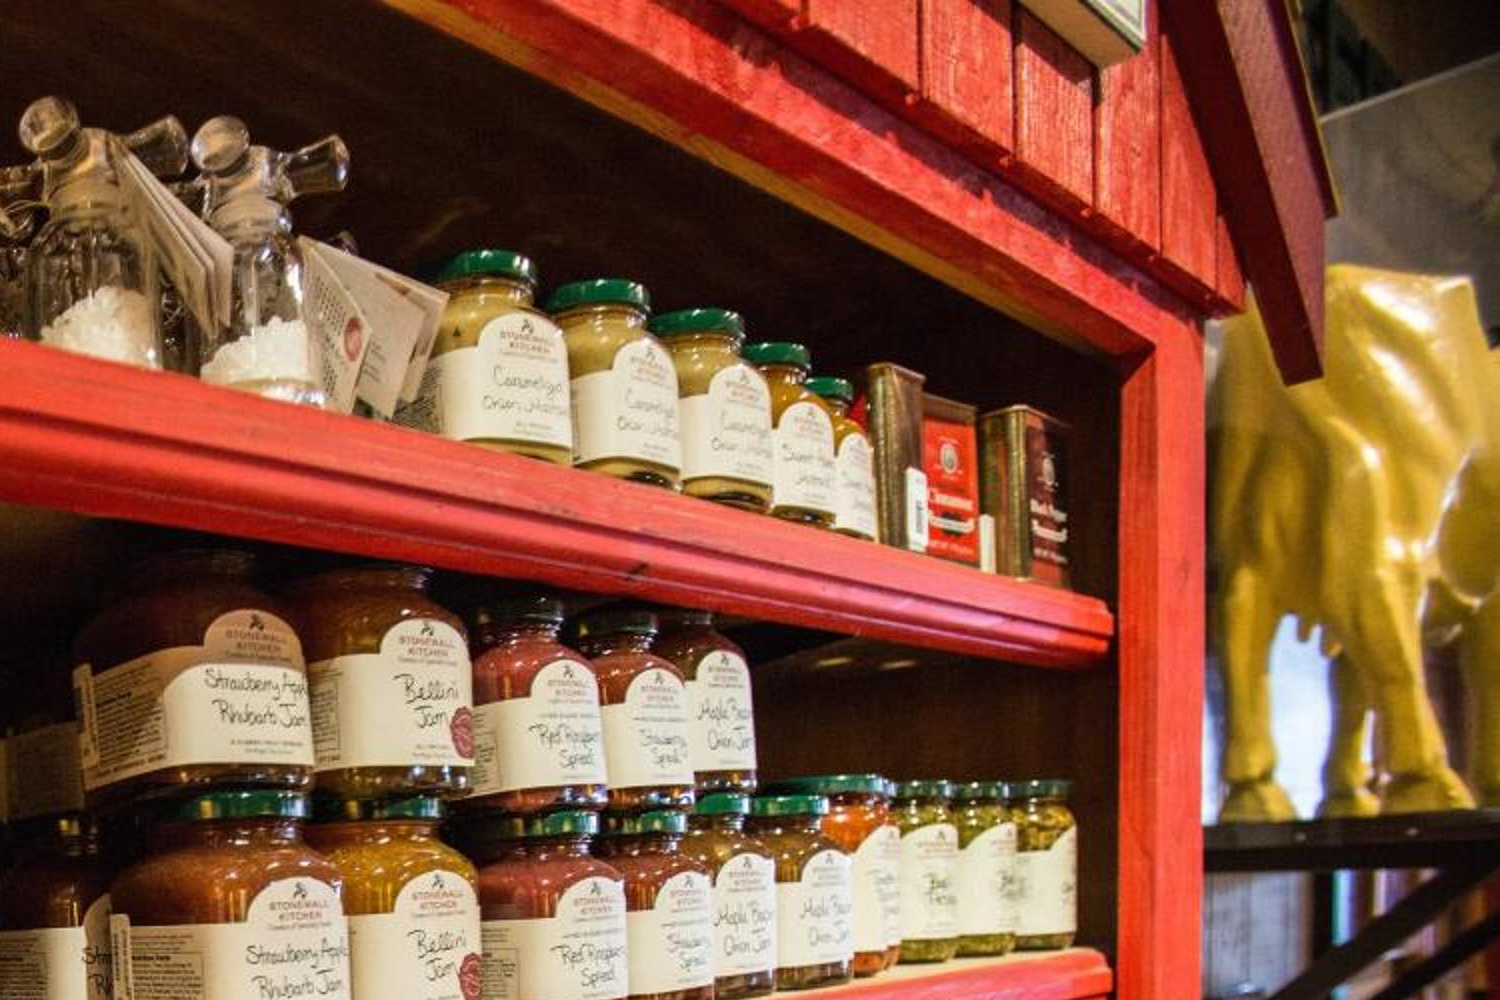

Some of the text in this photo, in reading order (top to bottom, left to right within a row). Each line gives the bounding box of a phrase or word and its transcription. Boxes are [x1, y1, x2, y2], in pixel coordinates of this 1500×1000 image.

[203, 667, 282, 702] Strawberry
[211, 698, 278, 727] Rhubarb
[245, 942, 319, 970] Strawberry
[250, 974, 315, 1000] Rhubarb
